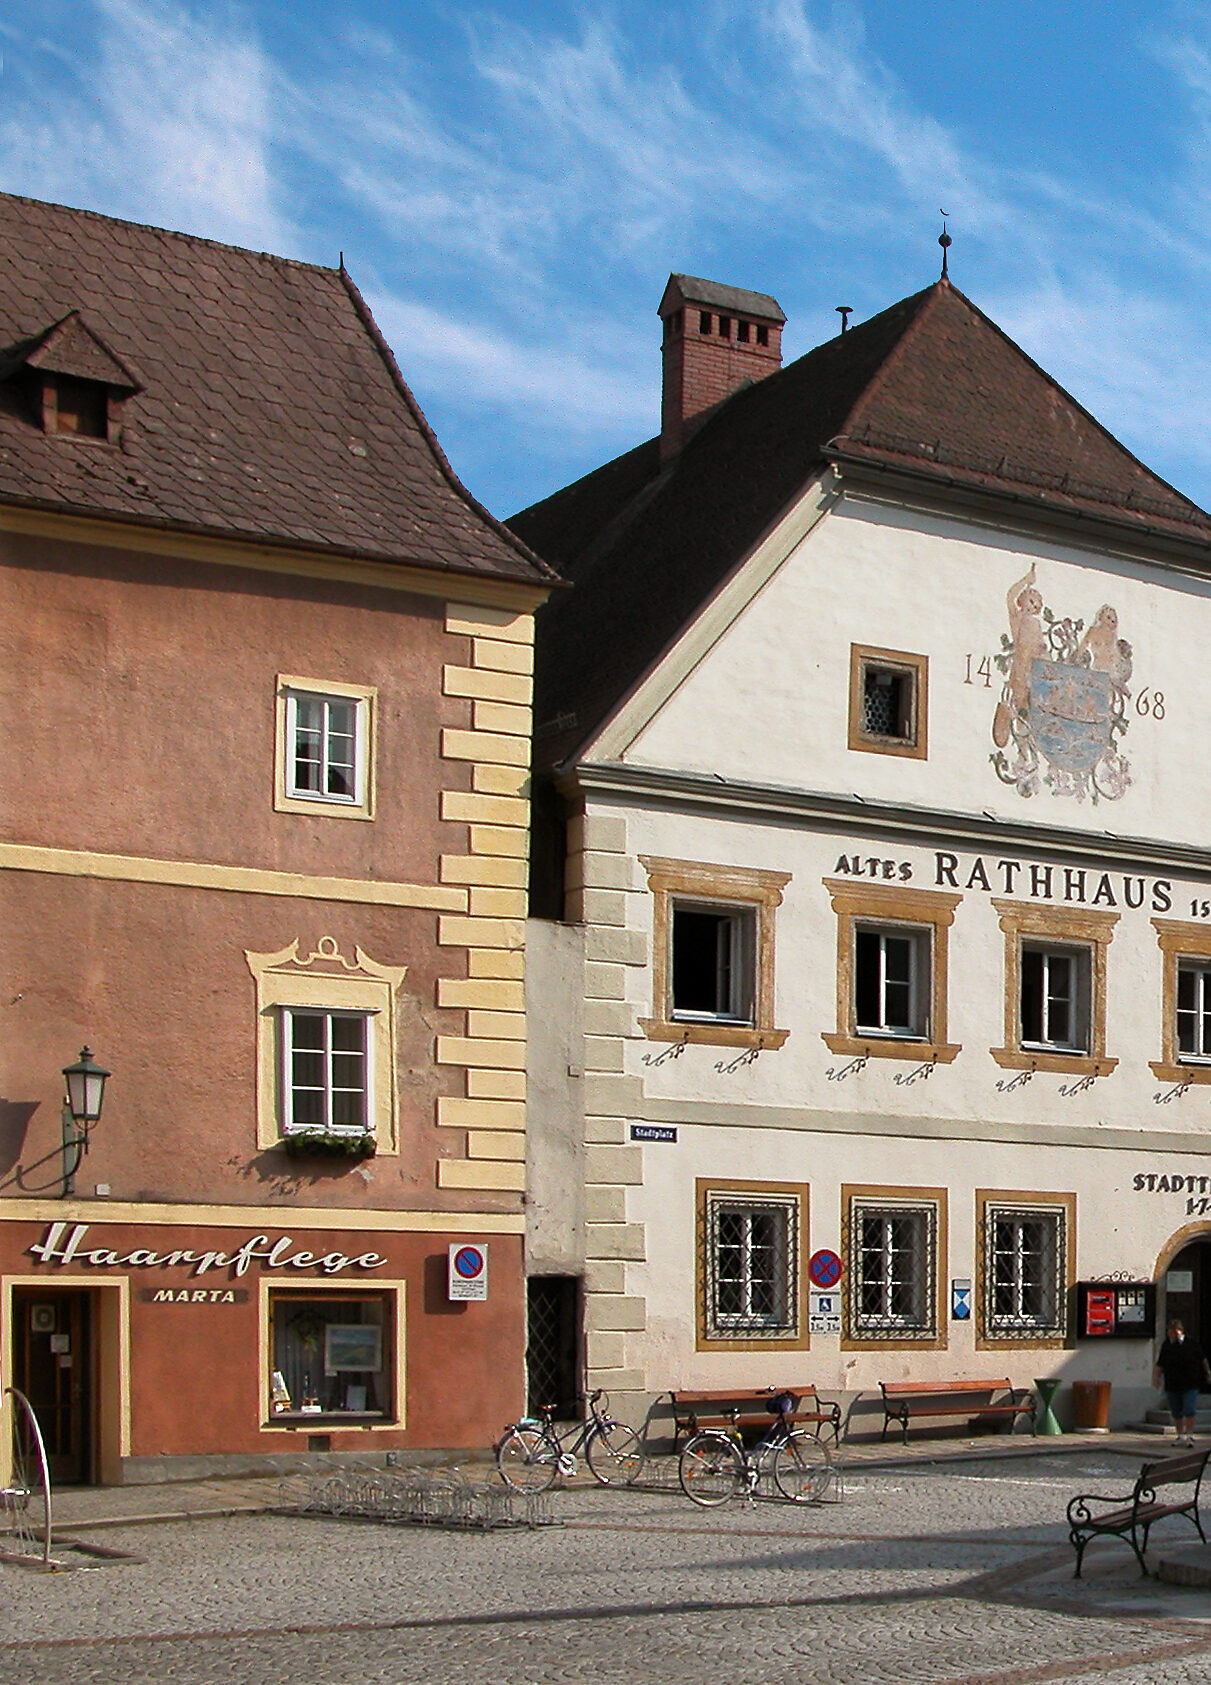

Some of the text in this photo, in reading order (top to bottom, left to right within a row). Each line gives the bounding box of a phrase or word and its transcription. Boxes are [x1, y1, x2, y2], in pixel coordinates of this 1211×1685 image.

[963, 653, 992, 688] 14
[1135, 686, 1166, 721] 68
[834, 853, 913, 882] ALTES
[934, 851, 1173, 913] RATHHAUS
[635, 1127, 674, 1140] Stadtplatz
[30, 1222, 388, 1278] Haarpflege
[153, 1289, 235, 1303] MARTA
